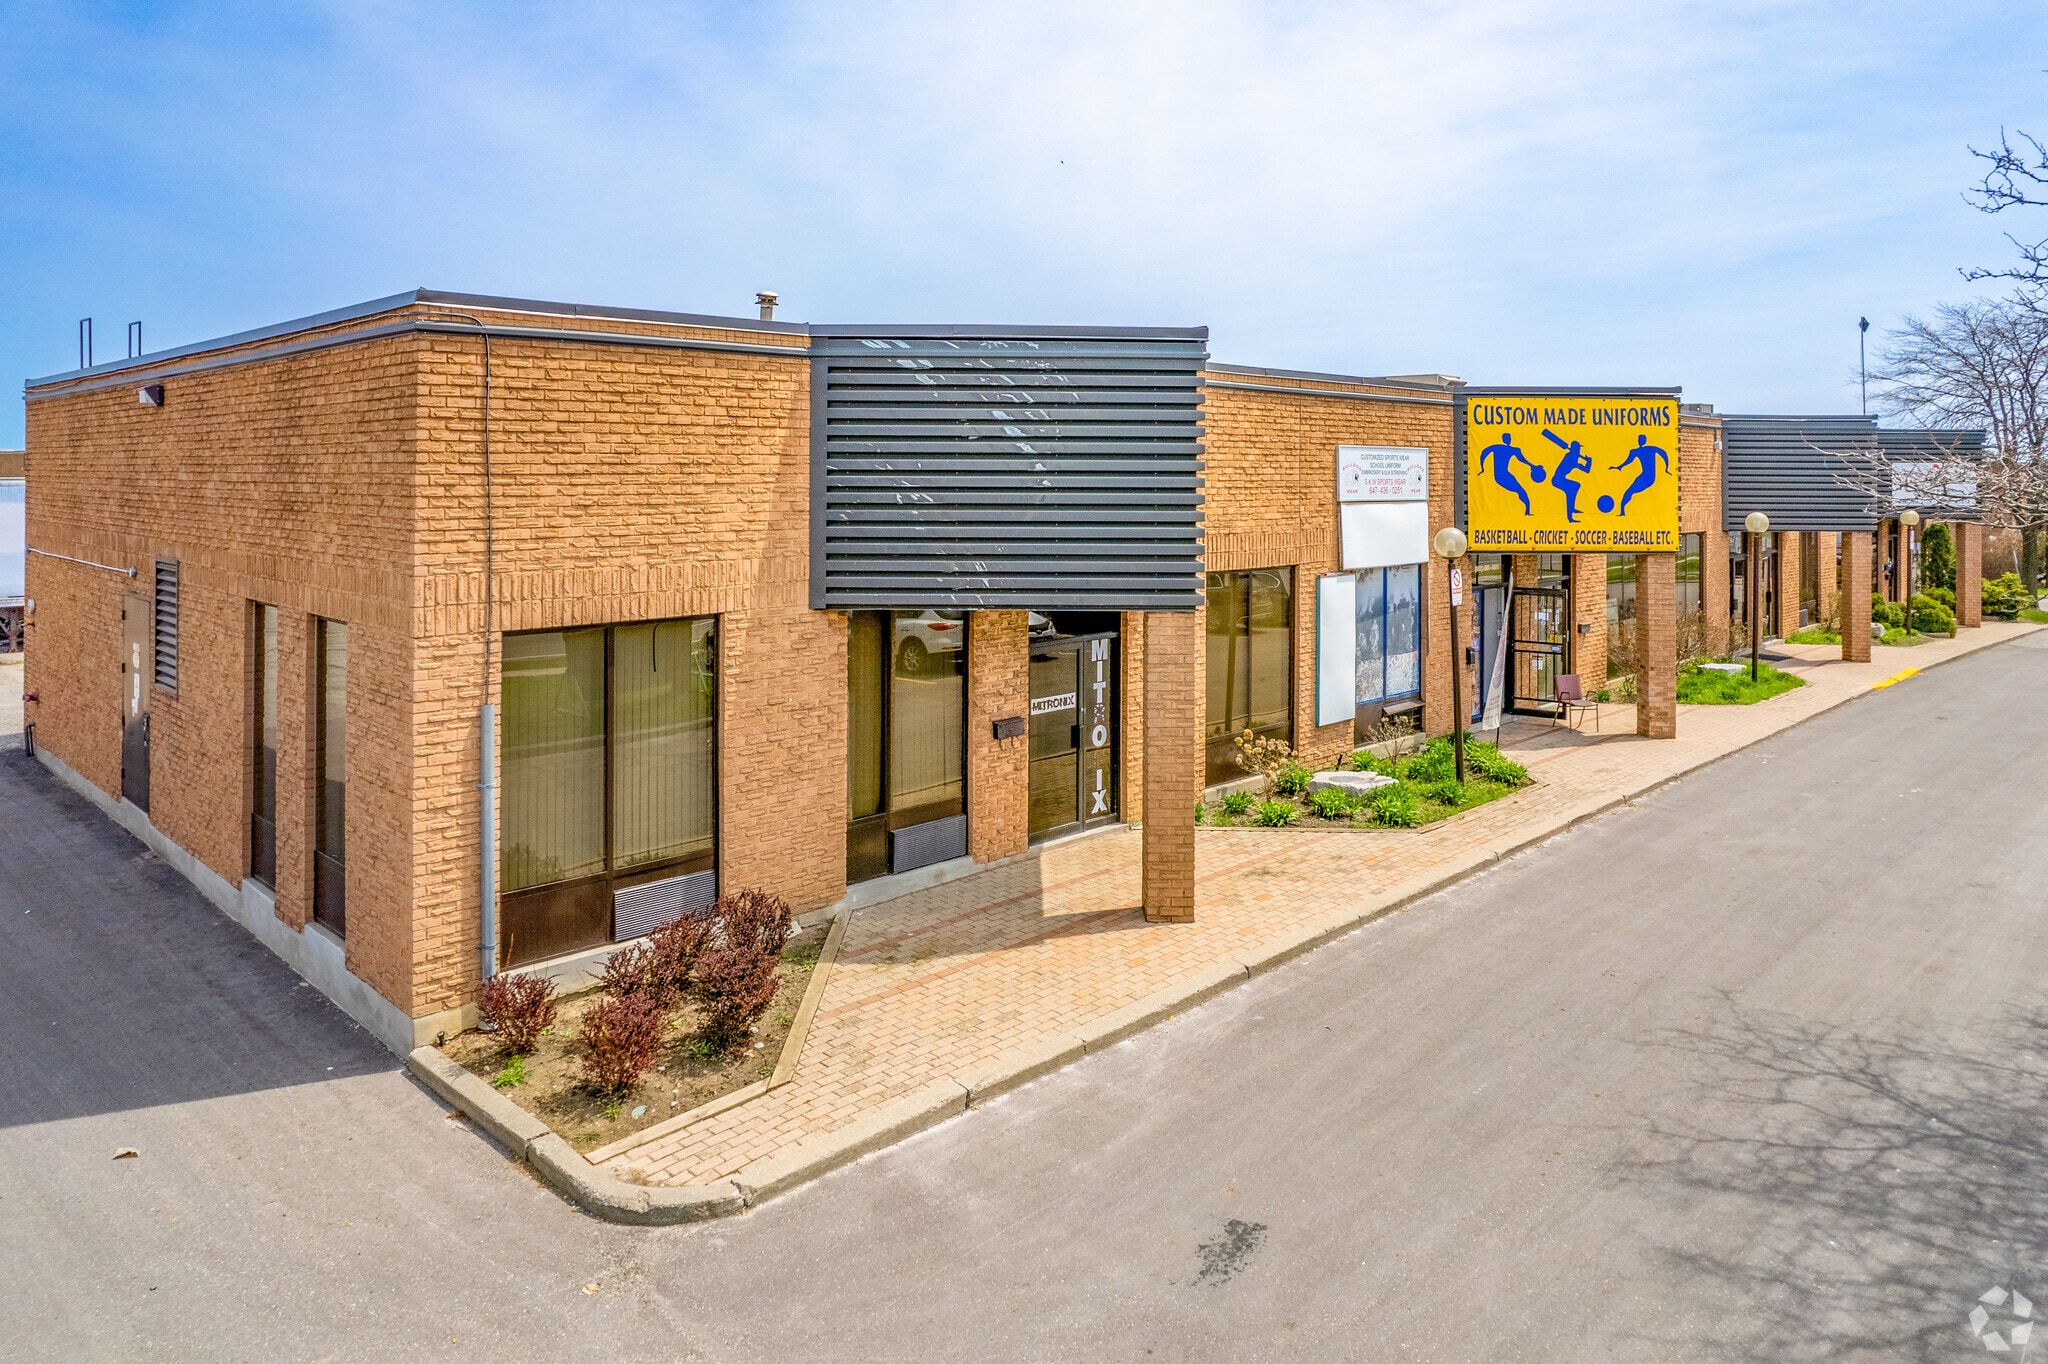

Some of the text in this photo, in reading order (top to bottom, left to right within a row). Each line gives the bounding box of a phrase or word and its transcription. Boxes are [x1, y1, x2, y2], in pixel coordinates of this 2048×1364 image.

[1473, 404, 1671, 427] CUSTOM MADE UNIFORMS
[1474, 529, 1674, 545] BASKETBALL CRICKET SOCCER BASEBALL ETC.
[1032, 695, 1074, 711] MITRONIX
